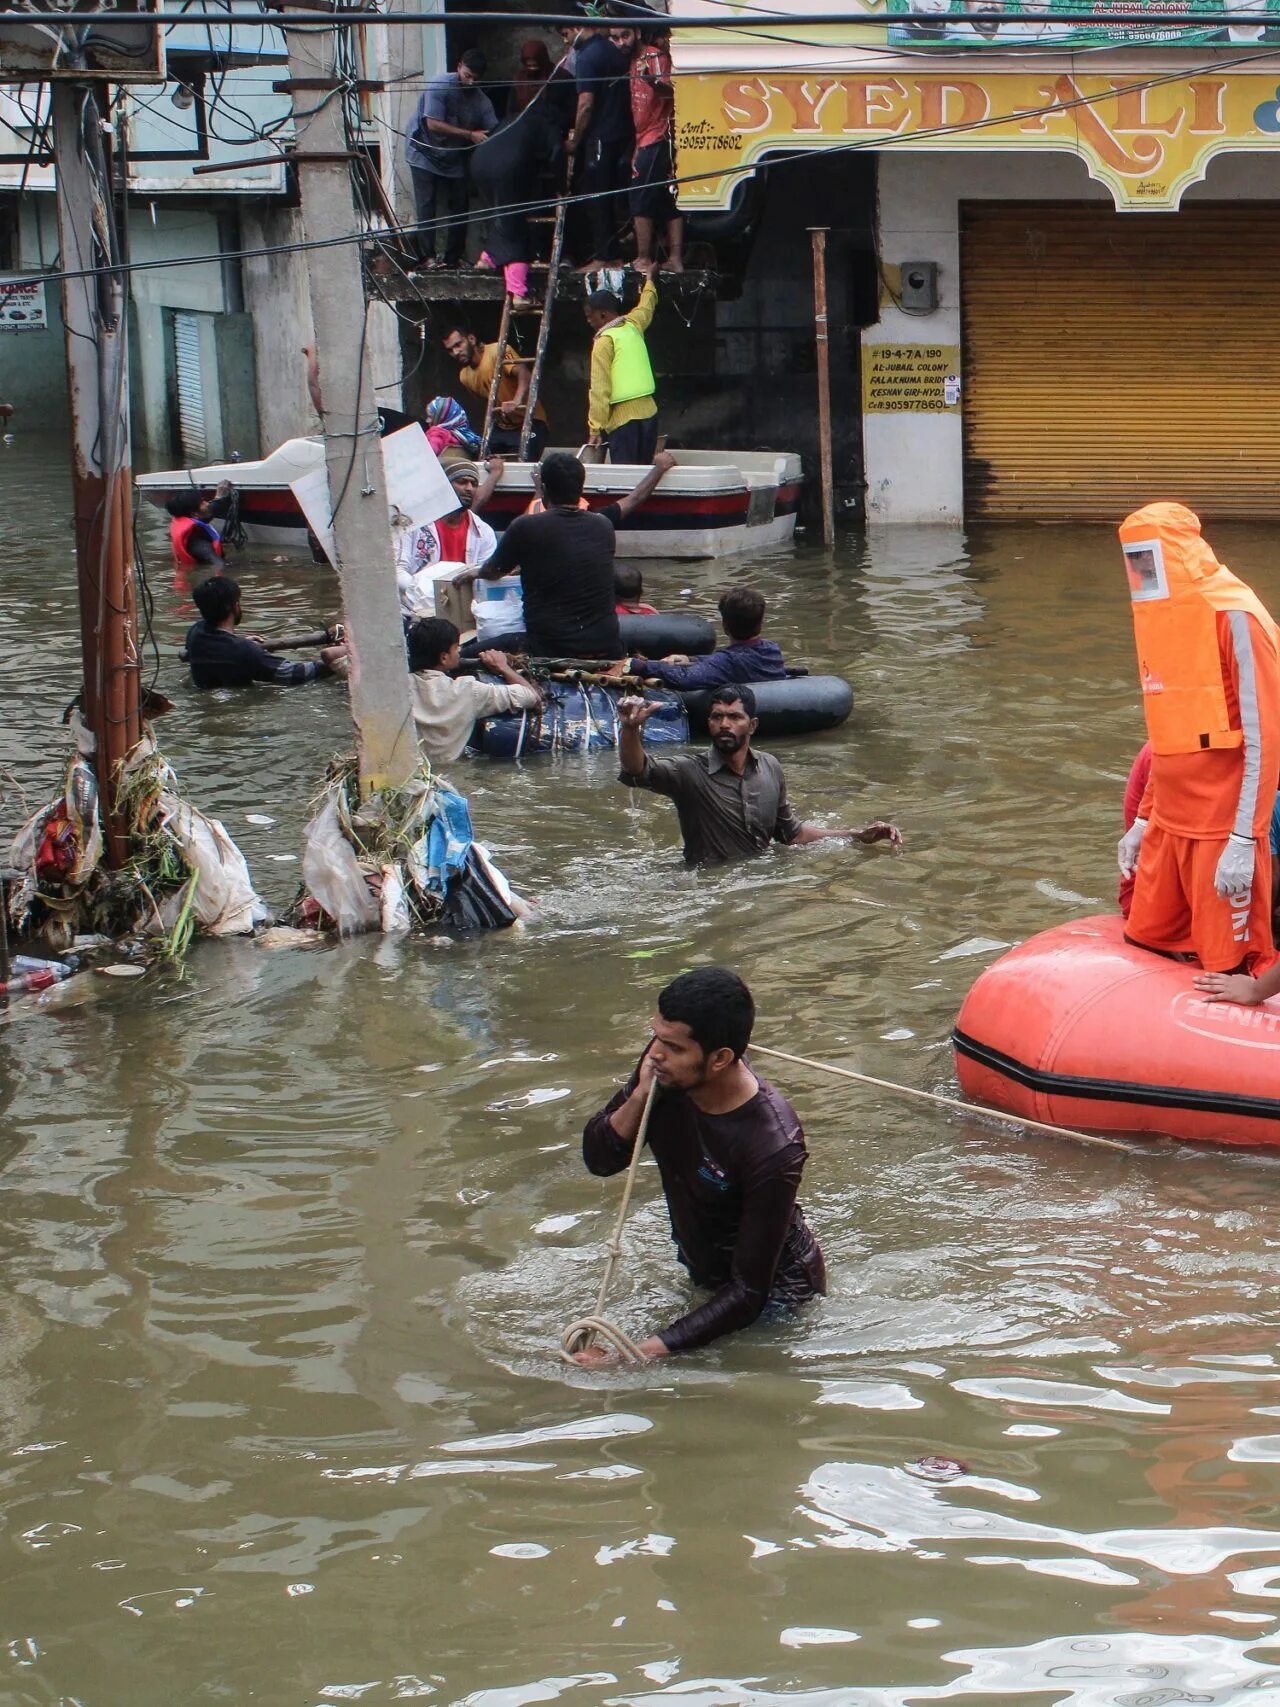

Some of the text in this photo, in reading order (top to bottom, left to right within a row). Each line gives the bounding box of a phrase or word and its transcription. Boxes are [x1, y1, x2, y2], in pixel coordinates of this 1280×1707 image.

[1148, 3, 1191, 14] COLONY
[720, 77, 993, 135] SYED
[1012, 74, 1227, 180] ALI
[917, 364, 949, 372] COLONY
